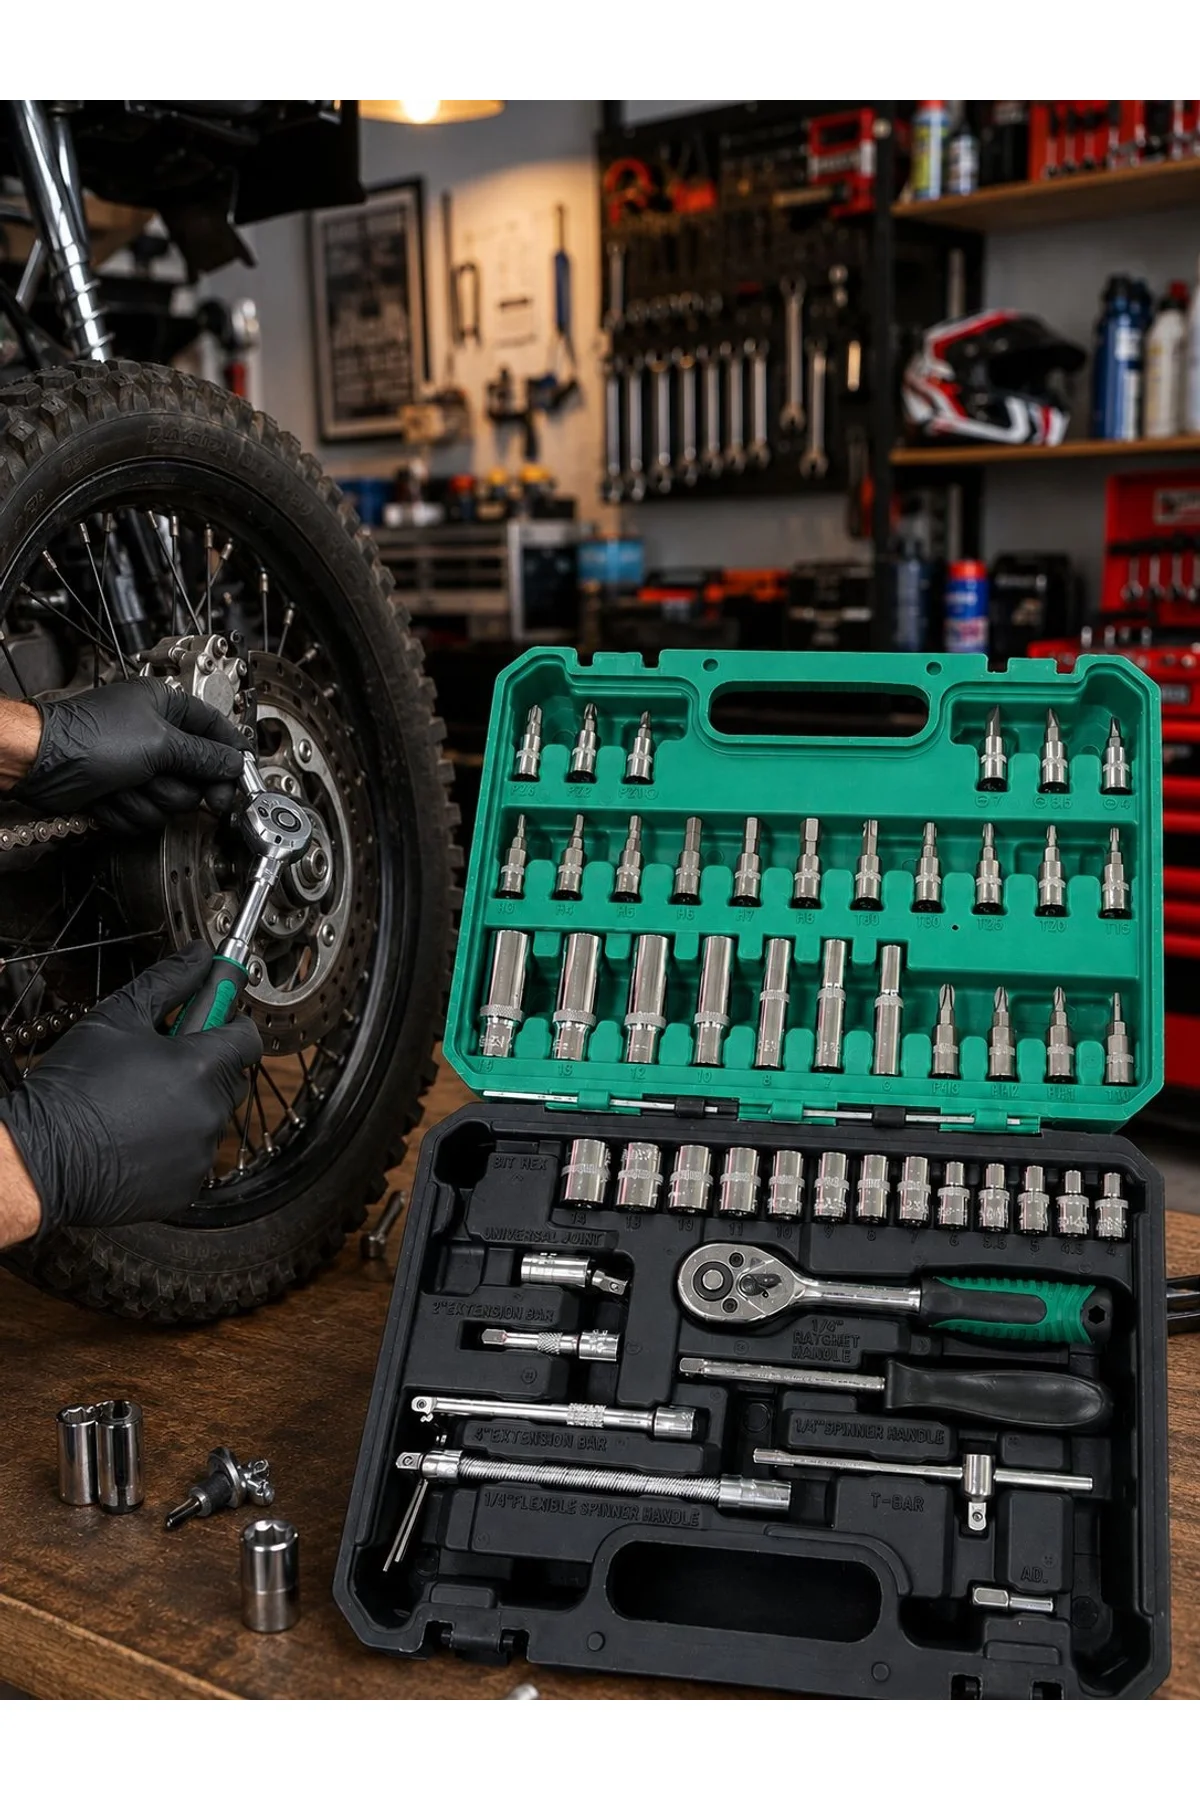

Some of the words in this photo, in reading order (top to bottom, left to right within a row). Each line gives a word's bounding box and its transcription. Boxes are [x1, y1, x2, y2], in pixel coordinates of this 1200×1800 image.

[491, 1155, 515, 1170] BIT
[483, 1226, 559, 1245] UNIVERSAL
[560, 1231, 604, 1247] JOINT
[728, 1222, 745, 1237] 11
[775, 1225, 793, 1240] 10
[523, 1307, 555, 1323] BAR
[576, 1434, 609, 1452] BAR
[886, 1424, 946, 1446] HANDLE
[870, 1491, 925, 1513] T-BAR
[578, 1502, 640, 1522] SPINNER
[641, 1508, 701, 1528] HANDLE
